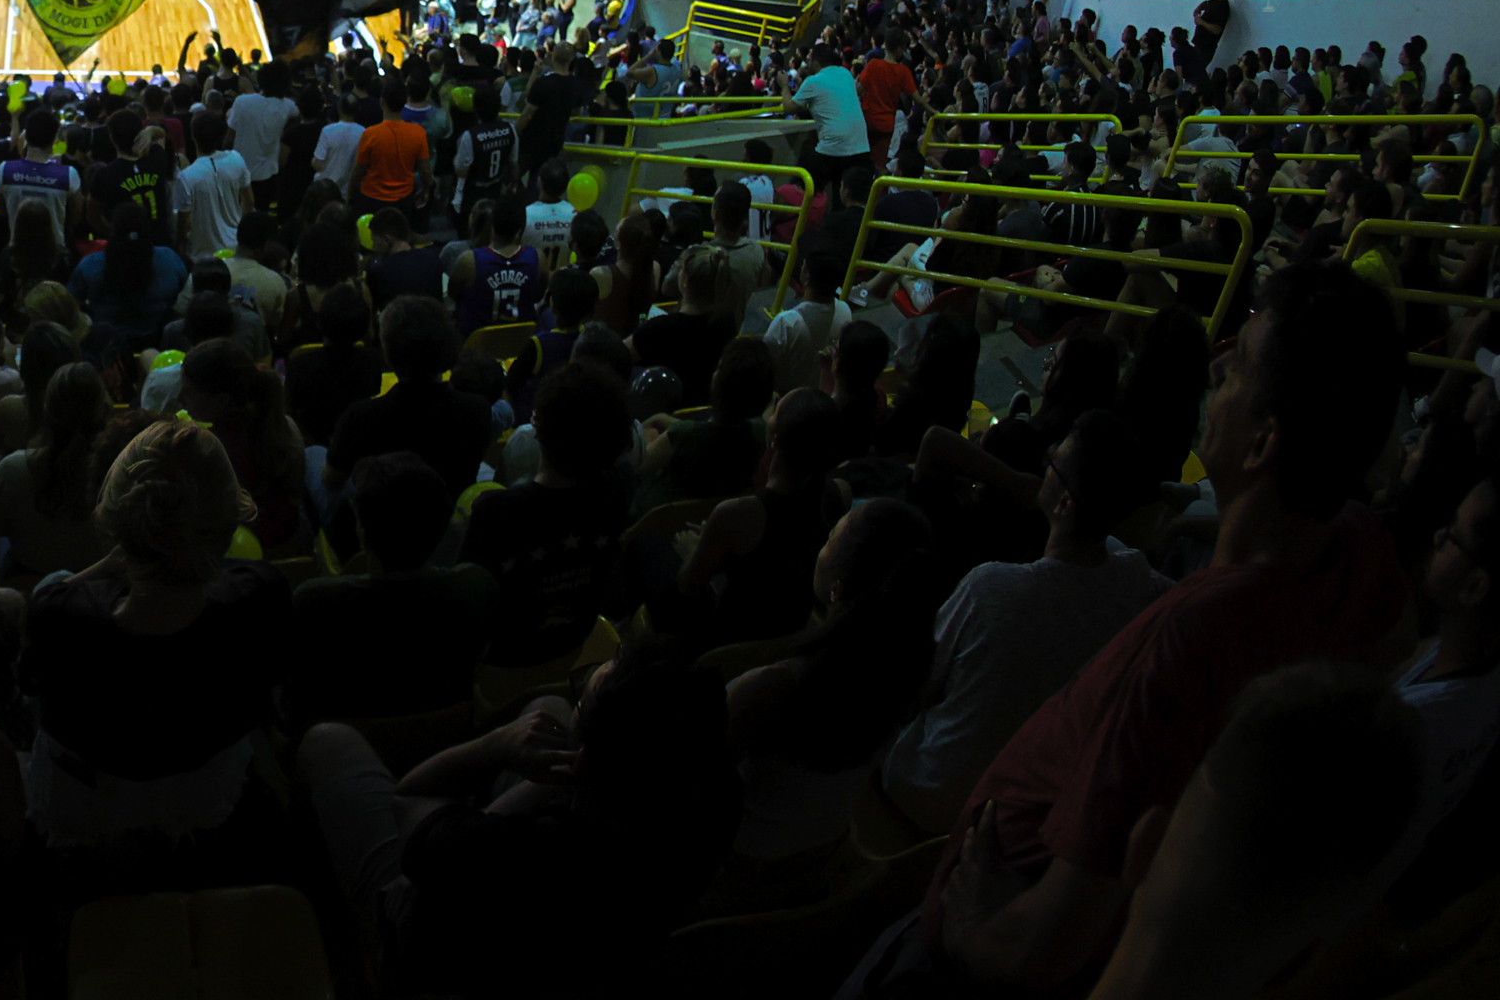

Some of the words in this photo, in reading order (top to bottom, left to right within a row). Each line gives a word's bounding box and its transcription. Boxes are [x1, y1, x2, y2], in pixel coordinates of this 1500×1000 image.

[49, 8, 88, 29] MOGI
[120, 173, 159, 192] YOUNG
[486, 268, 529, 290] GEORGE
[491, 288, 521, 321] 13
